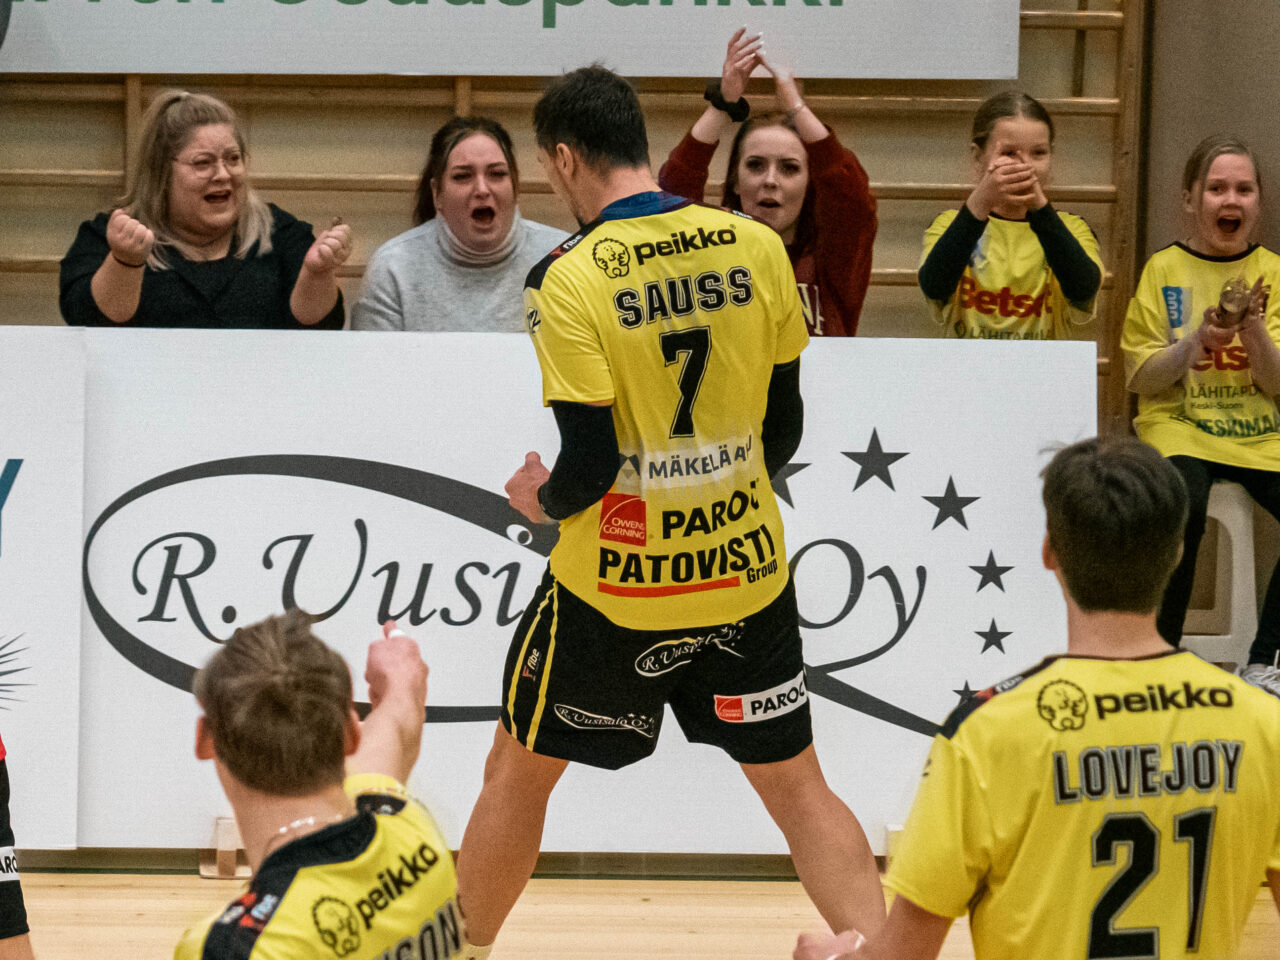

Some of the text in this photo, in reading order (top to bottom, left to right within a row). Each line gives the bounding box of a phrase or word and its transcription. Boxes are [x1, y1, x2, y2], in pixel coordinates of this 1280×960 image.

[633, 227, 737, 266] peikko
[613, 265, 754, 330] SAUSS
[658, 325, 712, 439] 7
[648, 444, 732, 480] MÄKELÄ
[598, 523, 776, 583] PATOVISTI
[603, 524, 645, 540] CORNING
[132, 519, 927, 672] R. Uusi Oy
[746, 558, 778, 583] Group
[1094, 682, 1234, 720] peikko
[1053, 739, 1244, 805] LOVEJOY
[355, 842, 439, 929] peikko
